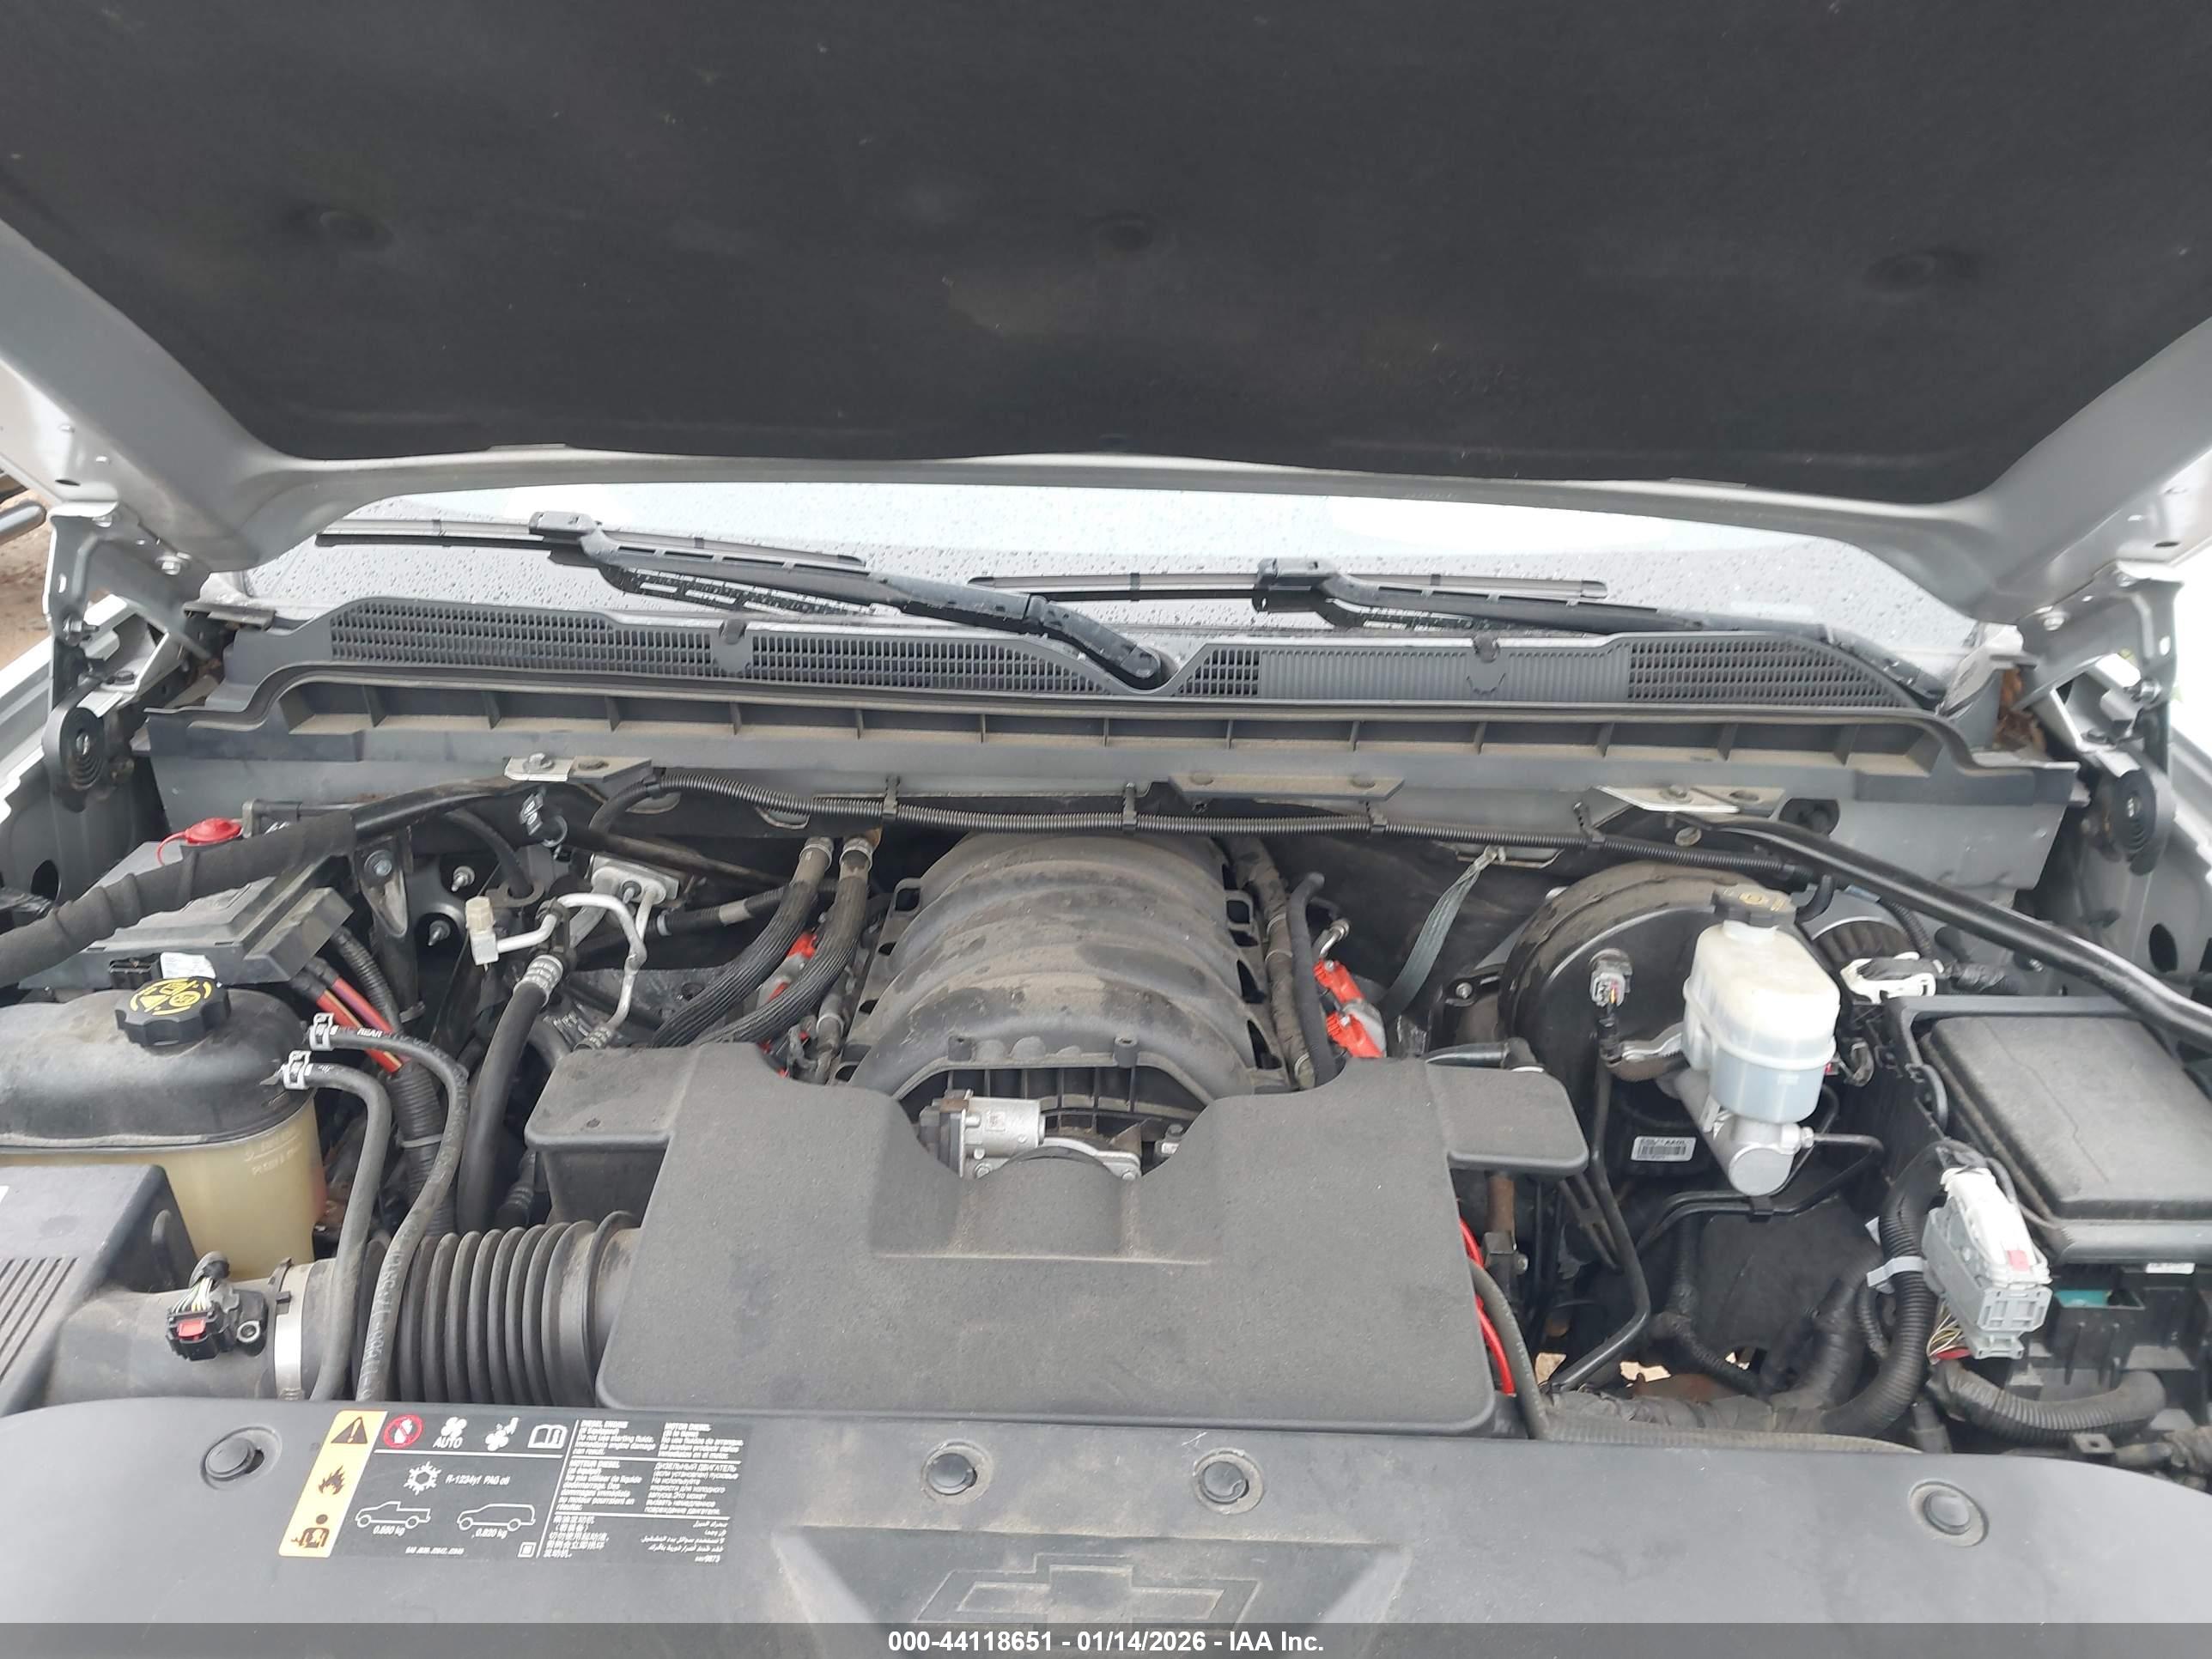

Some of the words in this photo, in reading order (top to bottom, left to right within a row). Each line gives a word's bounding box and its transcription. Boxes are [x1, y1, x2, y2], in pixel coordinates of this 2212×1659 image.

[433, 1437, 464, 1449] AUTO
[394, 1525, 405, 1536] kg
[496, 1529, 507, 1539] kg
